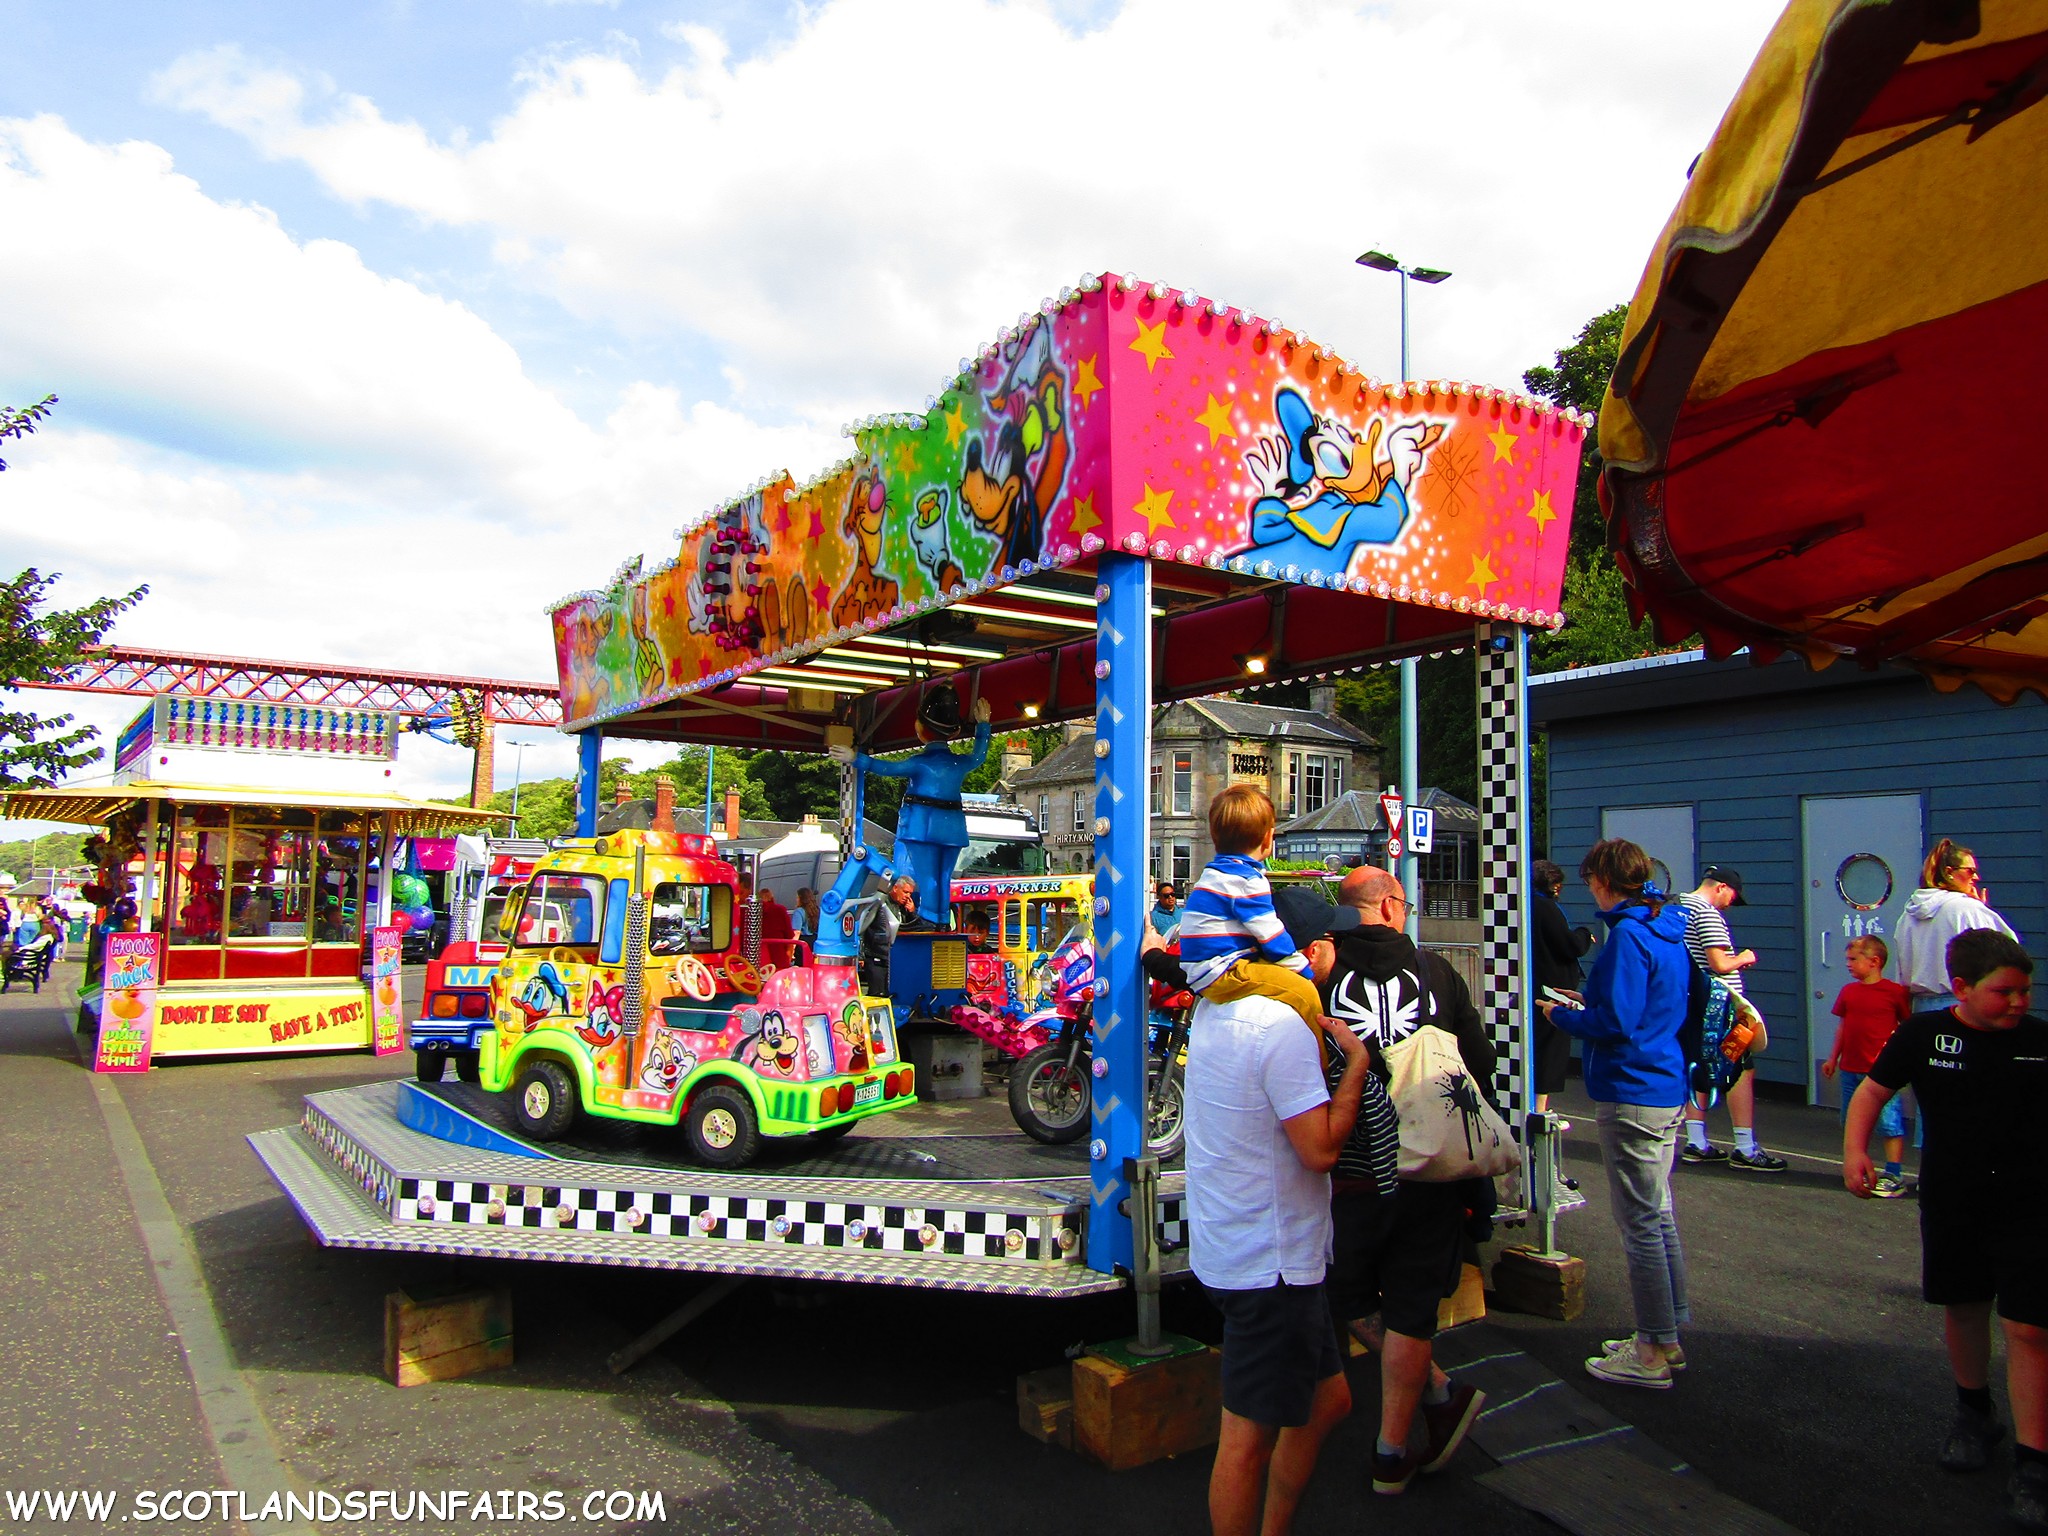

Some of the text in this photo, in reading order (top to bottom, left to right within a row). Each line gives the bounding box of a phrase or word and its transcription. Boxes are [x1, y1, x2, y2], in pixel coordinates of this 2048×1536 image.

[1232, 754, 1269, 765] THIRTY
[1232, 763, 1268, 776] KNOTS
[1386, 800, 1402, 809] GIVE
[1434, 805, 1479, 820] PUB
[1415, 812, 1426, 835] P
[1052, 833, 1077, 843] THIRTY
[1390, 843, 1400, 851] 20
[962, 881, 1062, 895] BUS WARNER
[844, 916, 853, 931] 60
[110, 938, 156, 955] HOOK
[376, 931, 400, 948] HOOK
[125, 955, 135, 966] A
[111, 963, 154, 989] DUCK
[161, 1004, 270, 1025] DONT BE SHY
[269, 1001, 365, 1043] HAVE A TRY!
[103, 1043, 145, 1054] EVERY
[1929, 1058, 1955, 1069] Mobil
